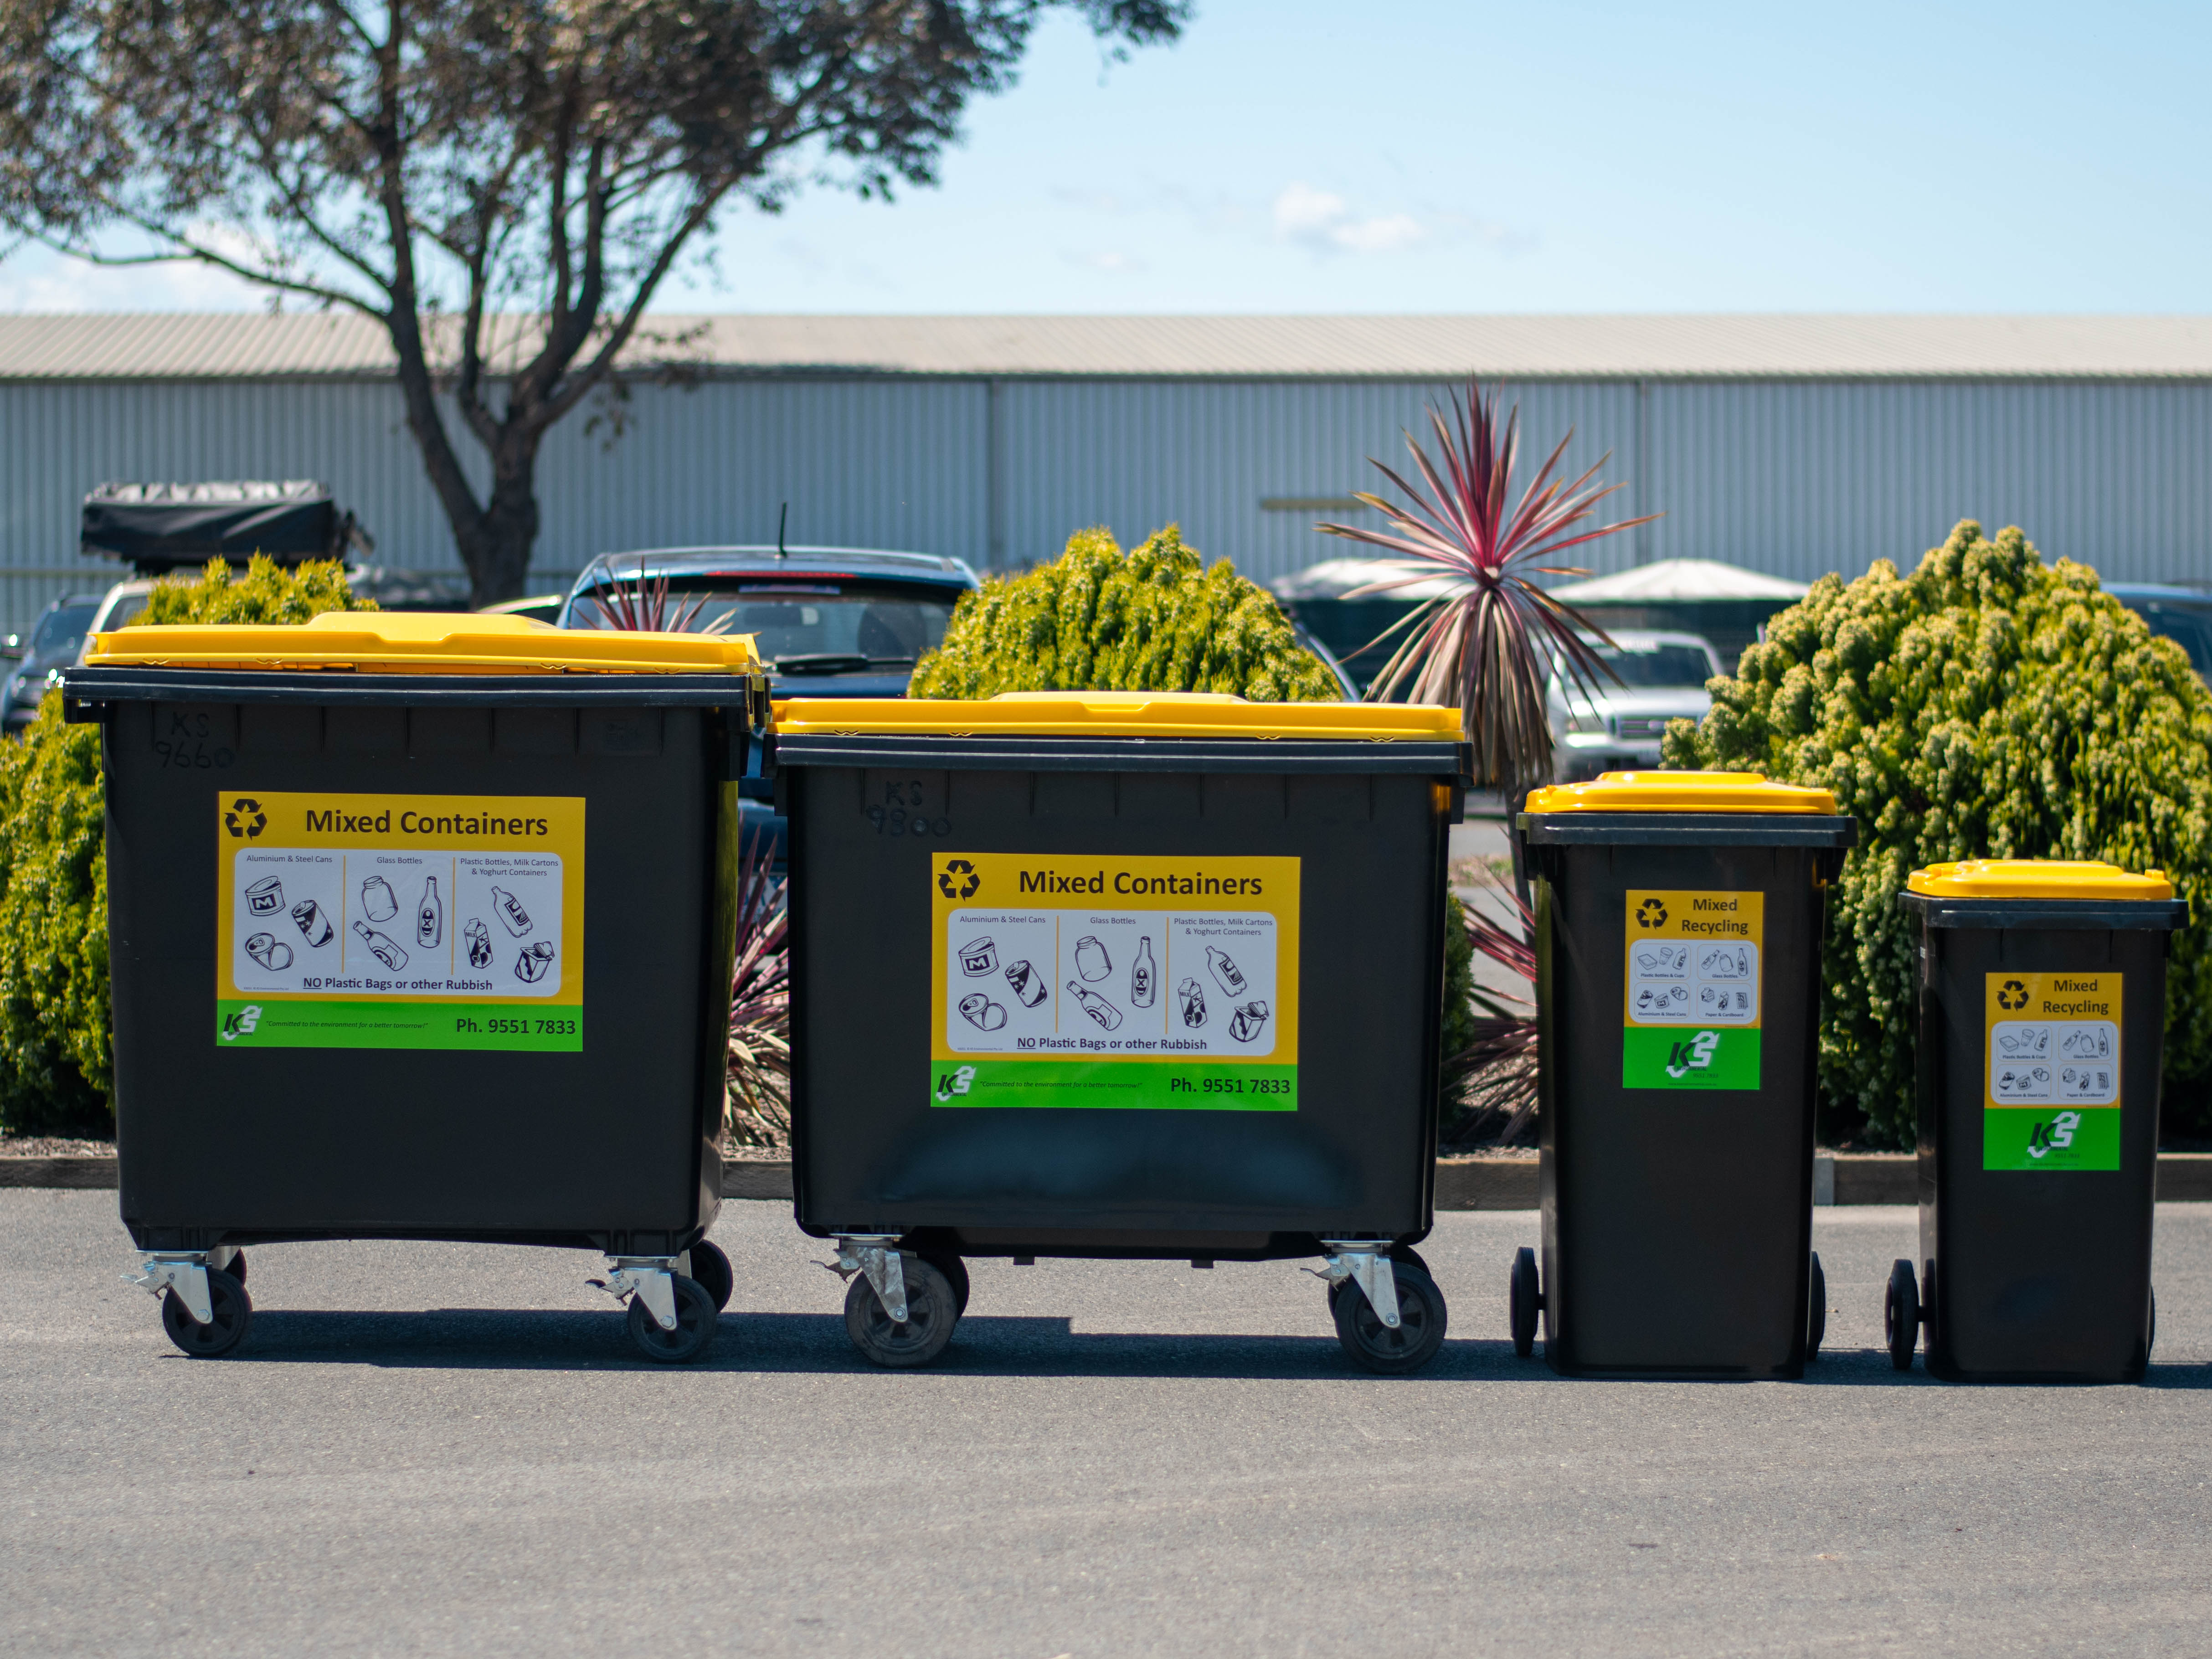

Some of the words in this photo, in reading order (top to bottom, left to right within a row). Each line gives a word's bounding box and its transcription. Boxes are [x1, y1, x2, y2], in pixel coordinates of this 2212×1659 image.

[306, 809, 390, 833] Mixed
[400, 811, 548, 835] Containers
[480, 868, 507, 876] Yoghurt
[1019, 871, 1104, 893] Mixed
[1114, 872, 1262, 895] Containers
[255, 896, 274, 908] M
[1693, 898, 1737, 911] Mixed
[1193, 928, 1221, 936] Yoghurt
[1682, 919, 1748, 935] Recycling
[969, 957, 987, 969] M
[304, 978, 322, 989] NO
[325, 978, 362, 988] Plastic
[365, 979, 392, 991] Bags
[396, 980, 408, 989] or
[411, 979, 442, 989] other
[447, 979, 493, 990] Rubbish
[2054, 979, 2098, 992] Mixed
[2043, 1000, 2109, 1015] Recycling
[223, 1005, 262, 1032] KS
[457, 1018, 482, 1033] Ph.
[489, 1019, 529, 1034] 9551
[535, 1020, 576, 1035] 7833
[1017, 1037, 1036, 1048] NO
[1039, 1037, 1076, 1048] Plastic
[1080, 1038, 1106, 1050] Bags
[1110, 1040, 1122, 1049] or
[1125, 1039, 1157, 1049] other
[1161, 1039, 1207, 1050] Rubbish
[1667, 1031, 1719, 1066] KS
[937, 1066, 977, 1093] KS
[1171, 1077, 1197, 1092] Ph.
[1203, 1078, 1244, 1093] 9551
[1250, 1079, 1290, 1094] 7833
[2029, 1112, 2081, 1147] KS
